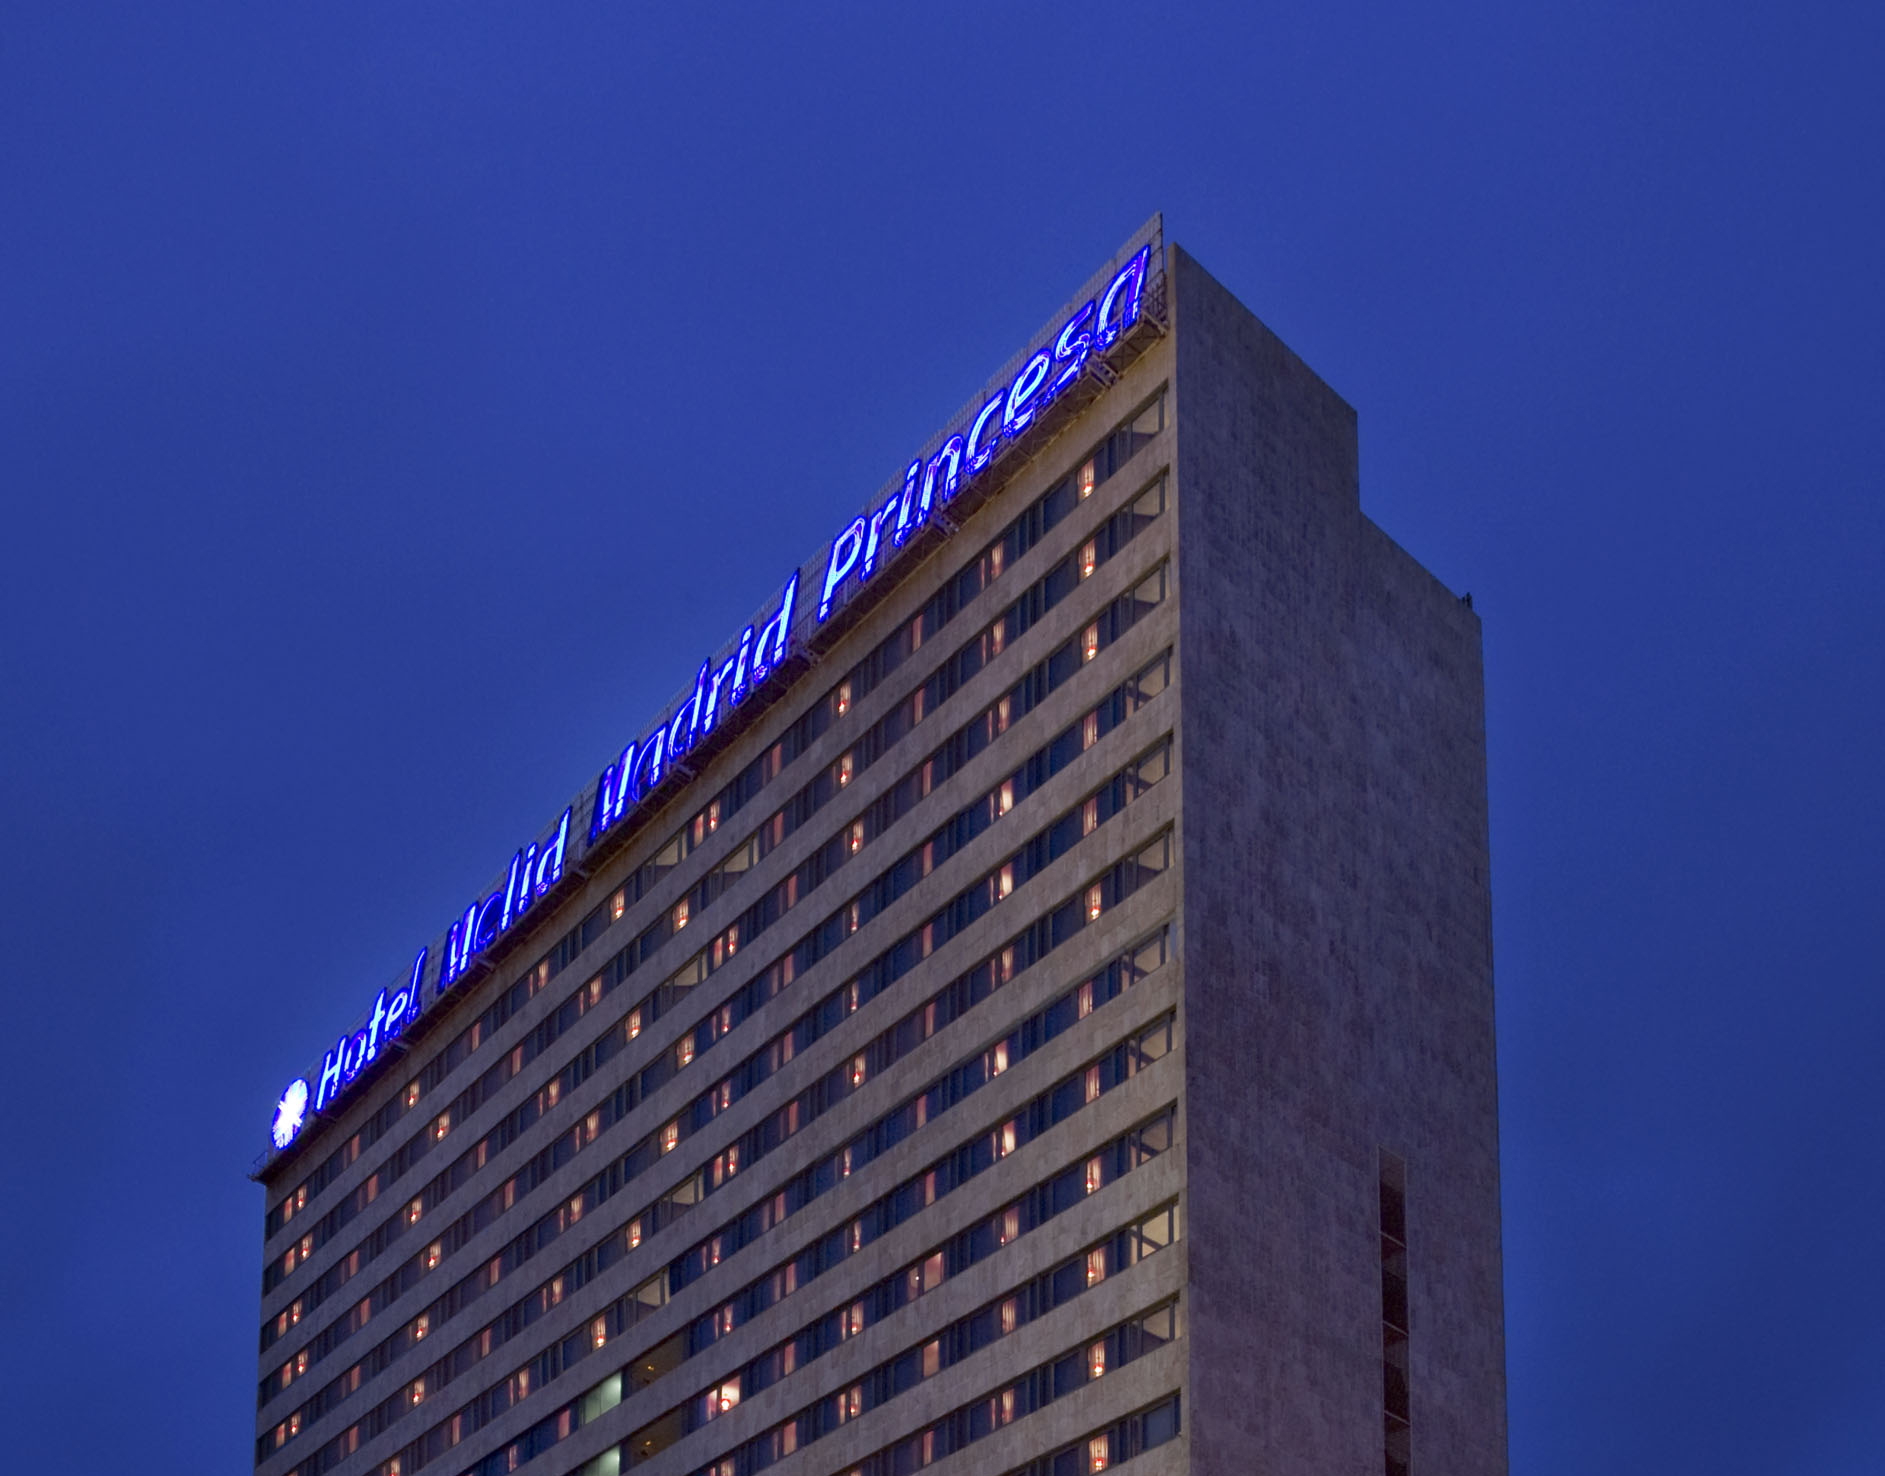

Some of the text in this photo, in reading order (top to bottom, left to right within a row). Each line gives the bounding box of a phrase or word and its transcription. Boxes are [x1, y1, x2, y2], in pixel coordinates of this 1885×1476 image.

[314, 946, 428, 1113] Hotel
[588, 567, 800, 848] Madrid
[817, 243, 1152, 623] Princesa
